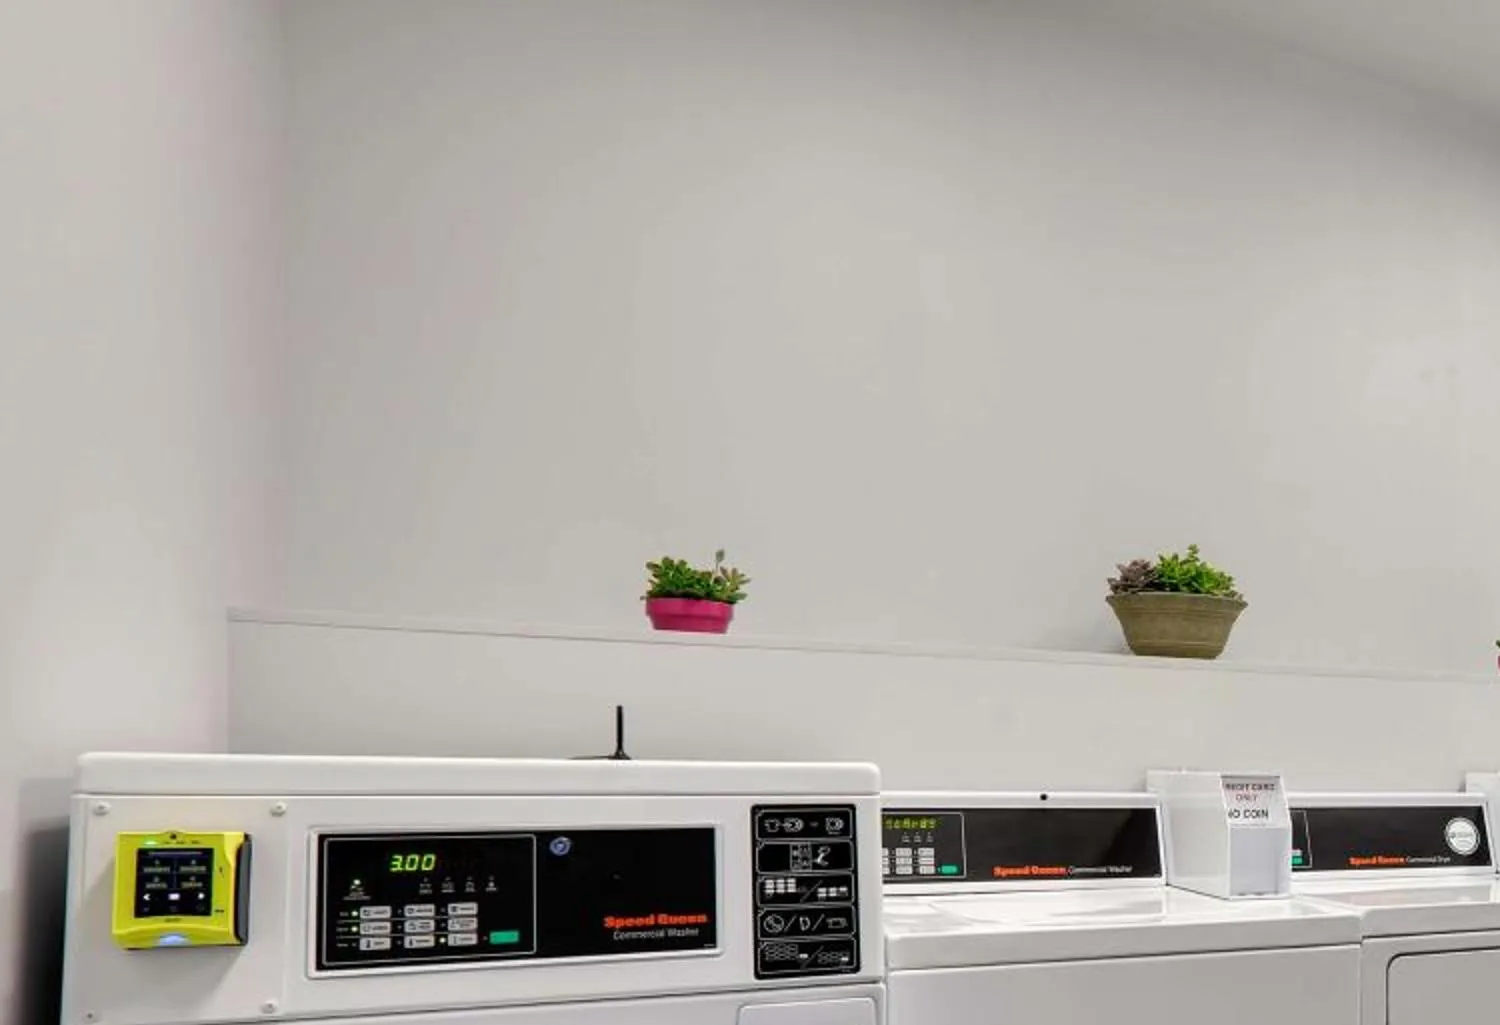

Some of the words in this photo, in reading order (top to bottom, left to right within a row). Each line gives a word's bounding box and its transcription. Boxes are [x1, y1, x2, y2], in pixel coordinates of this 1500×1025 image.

[1243, 808, 1269, 819] COIN
[390, 853, 437, 872] 3.00
[993, 865, 1029, 878] Speed
[1031, 865, 1066, 875] Queen
[603, 914, 655, 929] Speed
[657, 913, 707, 925] Queen
[613, 929, 665, 941] Commercial
[667, 927, 699, 938] Washer
